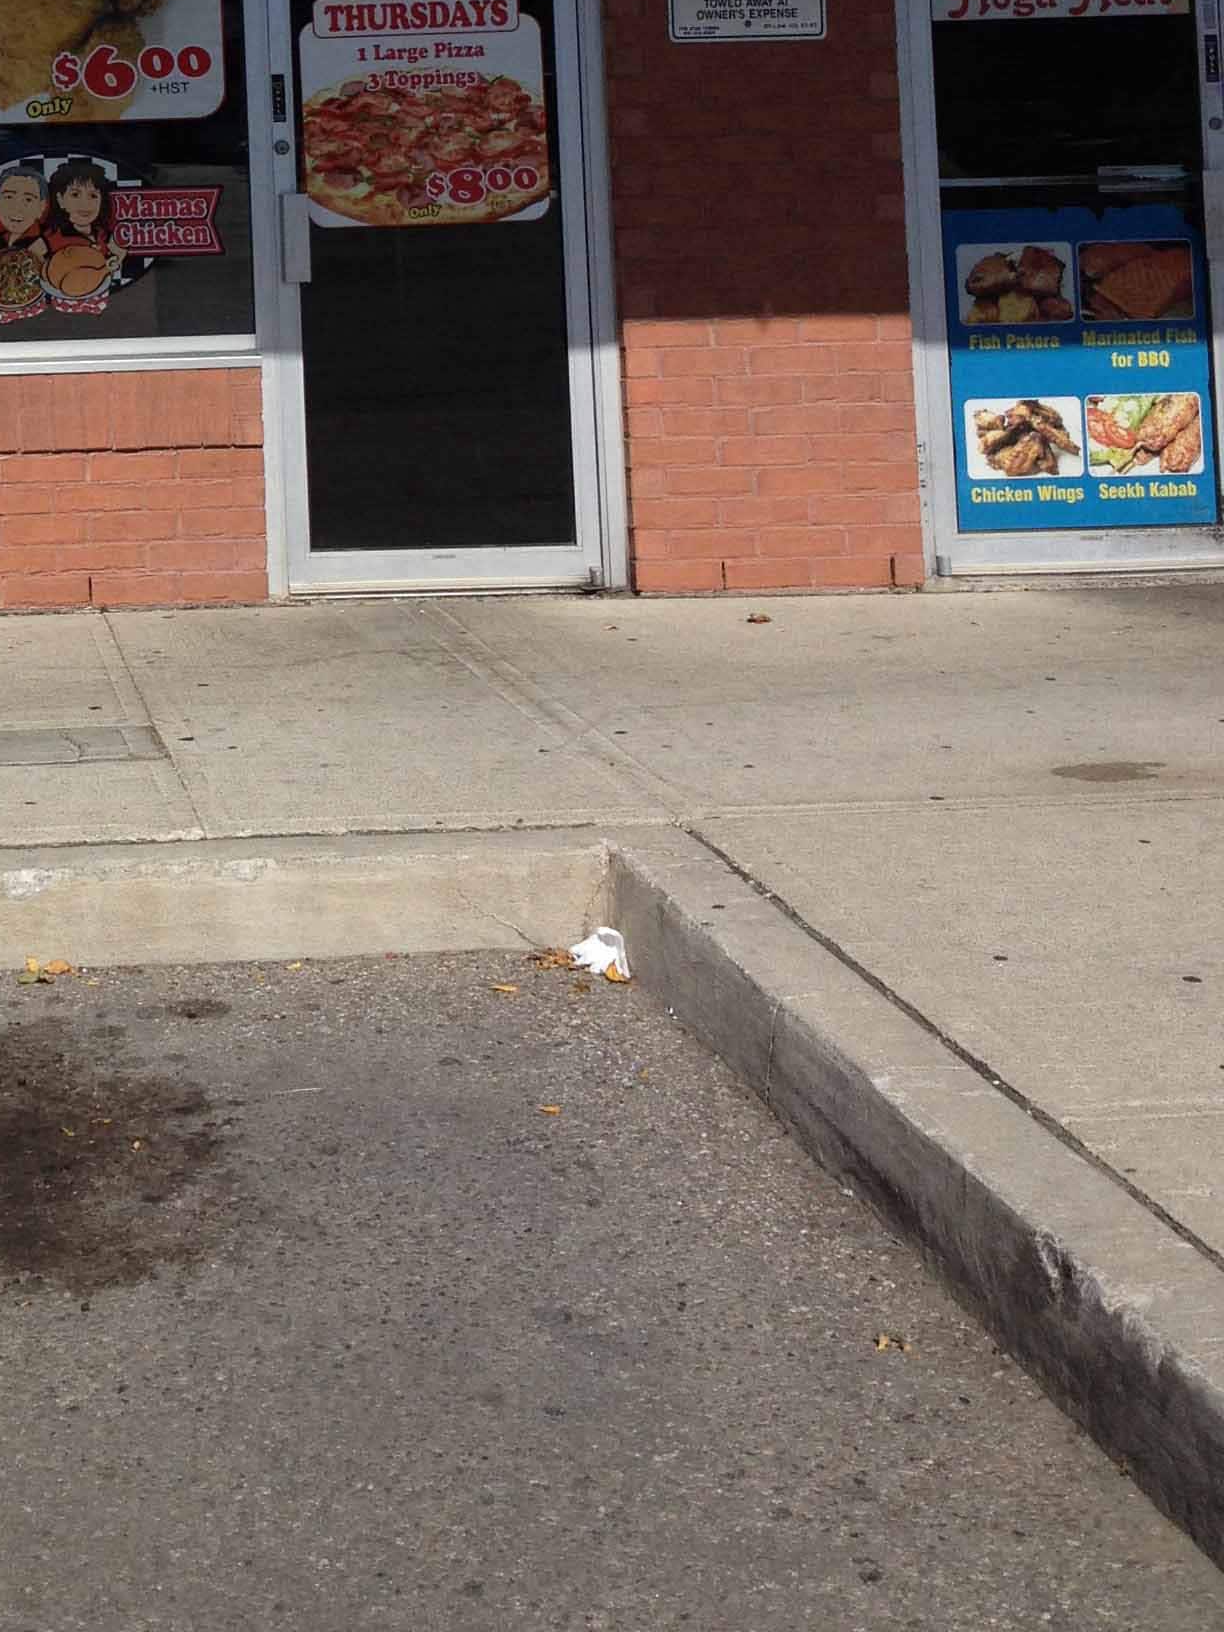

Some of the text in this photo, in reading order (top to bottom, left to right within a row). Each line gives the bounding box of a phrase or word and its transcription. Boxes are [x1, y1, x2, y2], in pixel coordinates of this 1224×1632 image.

[324, 0, 509, 33] THURSDAYS
[749, 8, 799, 19] EXPENSE
[356, 42, 485, 64] 1 Large Pizza
[384, 70, 477, 88] Toppings
[26, 96, 73, 118] Only
[116, 194, 207, 220] Mamas
[113, 220, 211, 248] Chicken
[969, 333, 1001, 350] Fish
[1082, 327, 1198, 346] Marinated Fish
[1111, 351, 1171, 367] for BBQ
[971, 484, 1085, 504] Chicken Wings
[1098, 480, 1197, 499] Seekh Kabab
